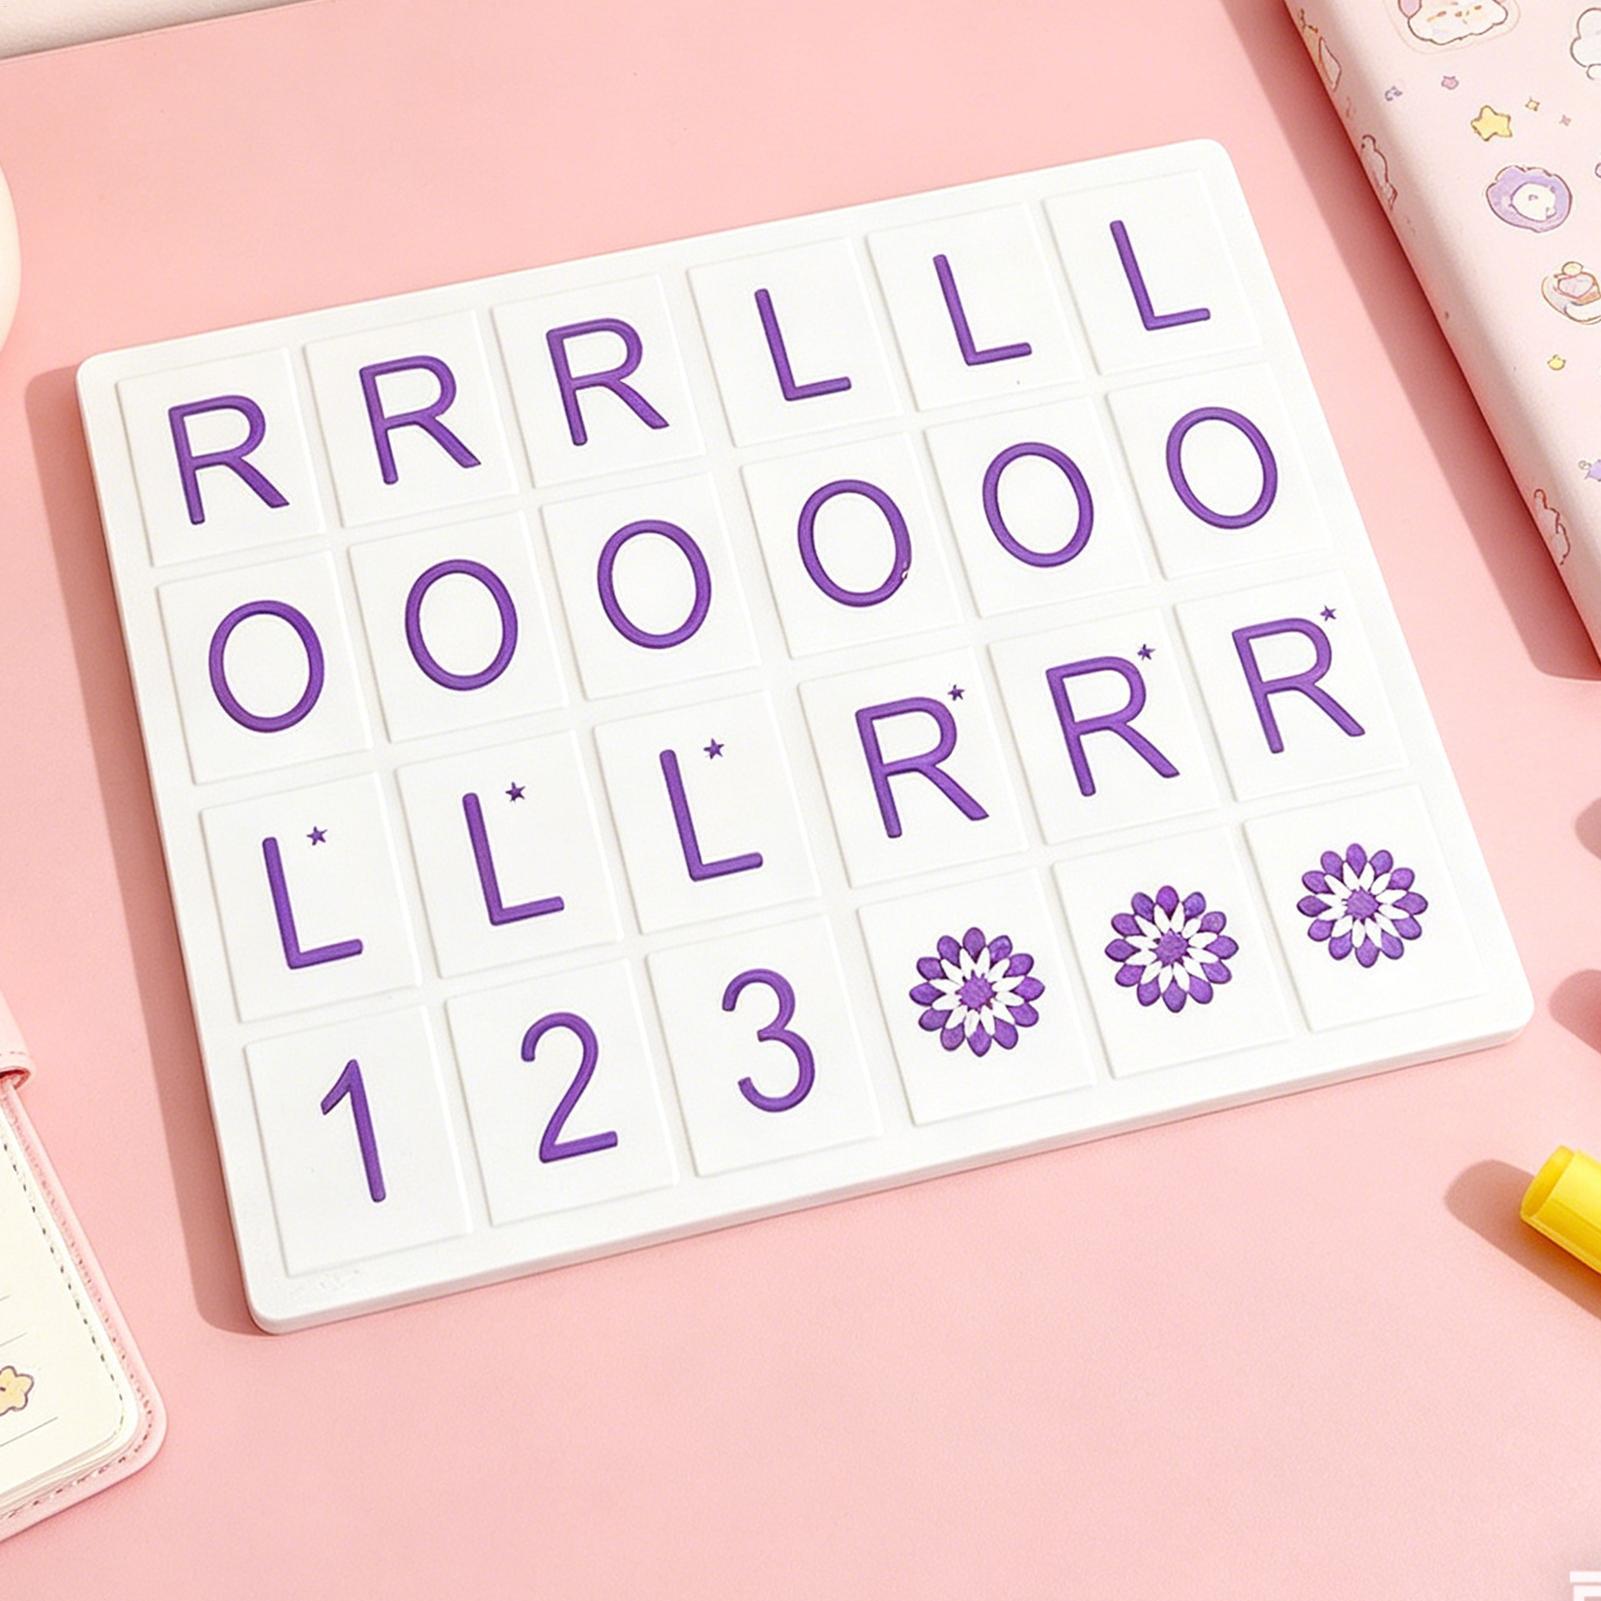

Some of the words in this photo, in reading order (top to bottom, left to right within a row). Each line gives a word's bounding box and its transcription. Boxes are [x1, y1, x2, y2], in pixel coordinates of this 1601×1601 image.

[169, 396, 288, 524] R
[360, 356, 480, 484] R
[547, 319, 668, 445] R
[756, 289, 851, 400] L
[934, 255, 1031, 365] L
[1111, 221, 1209, 330] L
[209, 601, 324, 732] O
[405, 560, 517, 691] O
[598, 520, 711, 649] O
[798, 480, 911, 607] O
[983, 443, 1093, 567] O
[1167, 408, 1277, 529] O
[263, 838, 363, 969] L
[463, 794, 564, 925] L
[660, 750, 763, 881] L
[856, 697, 988, 838] R
[1046, 657, 1179, 796] R
[1232, 619, 1364, 753] R
[321, 1060, 385, 1201] 1
[522, 1013, 617, 1162] 2
[723, 969, 815, 1112] 3
